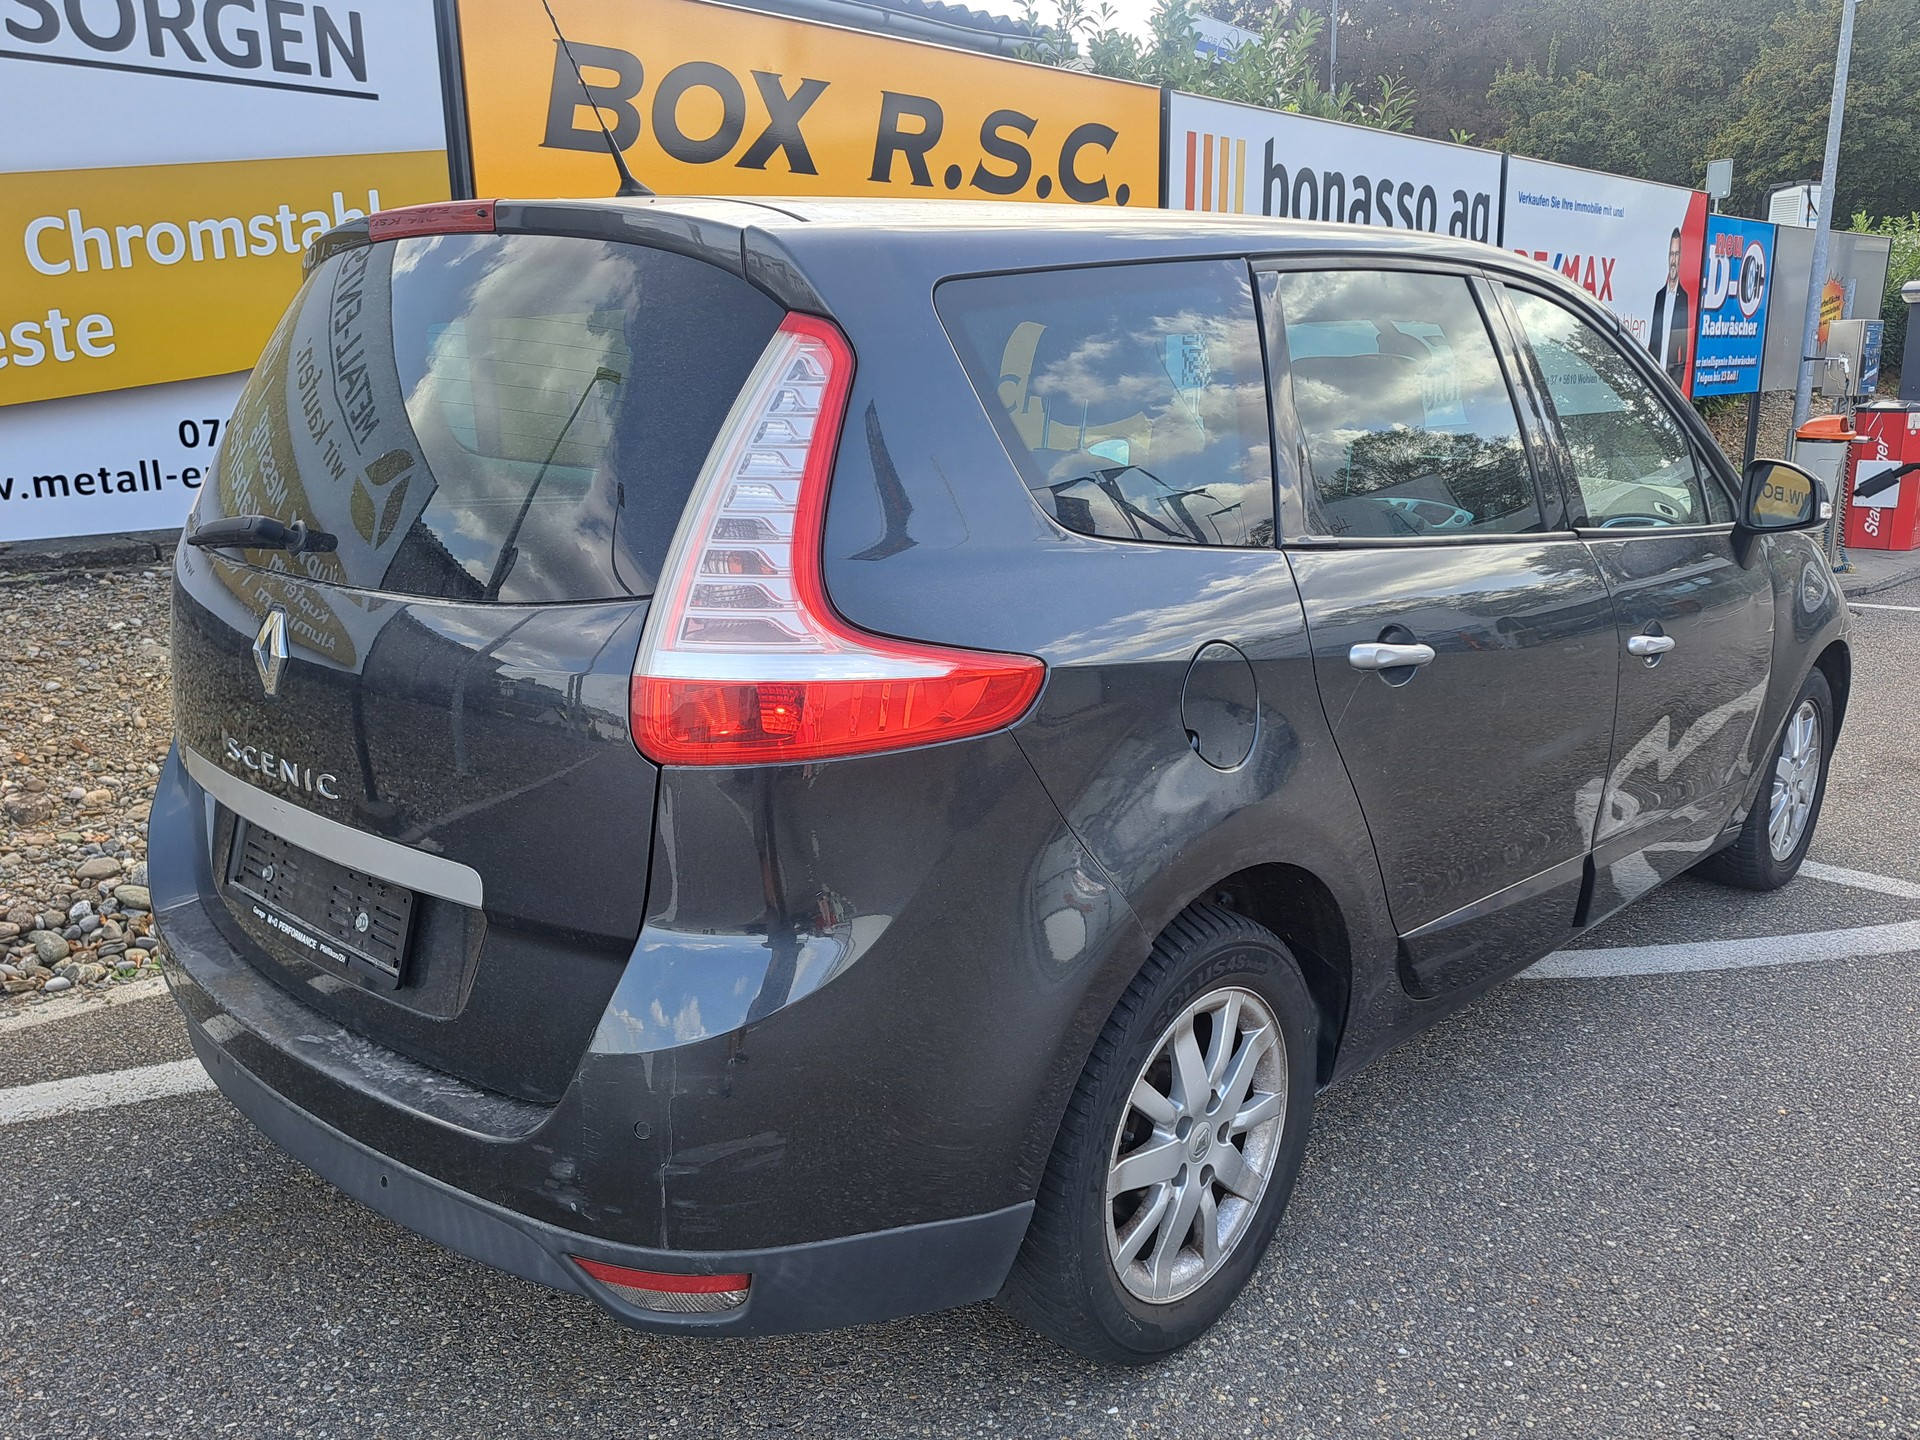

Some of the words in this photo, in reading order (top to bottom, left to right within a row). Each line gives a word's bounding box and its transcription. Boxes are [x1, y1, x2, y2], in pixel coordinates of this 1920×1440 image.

[4, 0, 368, 83] SORGEN
[538, 38, 831, 176] BOX
[866, 90, 1131, 207] R.S.C.
[1262, 136, 1437, 233] bonasso
[1449, 189, 1490, 244] ag
[1518, 190, 1549, 208] Verkaufen
[1550, 196, 1560, 209] Sie
[1561, 197, 1573, 211] Ihre
[1574, 199, 1602, 215] Immobilie
[1602, 204, 1612, 216] mit
[1613, 206, 1624, 218] uns!
[1715, 232, 1744, 257] neu
[1701, 314, 1758, 337] Radwäscher
[1701, 355, 1728, 369] intelligente
[1728, 354, 1758, 367] Radwäscher!
[1713, 370, 1721, 382] bis
[1562, 373, 1577, 385] 5610
[1577, 373, 1597, 384] Wohlen
[178, 417, 230, 450] 07
[0, 459, 209, 500] .metall-e
[226, 737, 340, 800] SCENIC
[278, 920, 318, 950] PERFORMANCE
